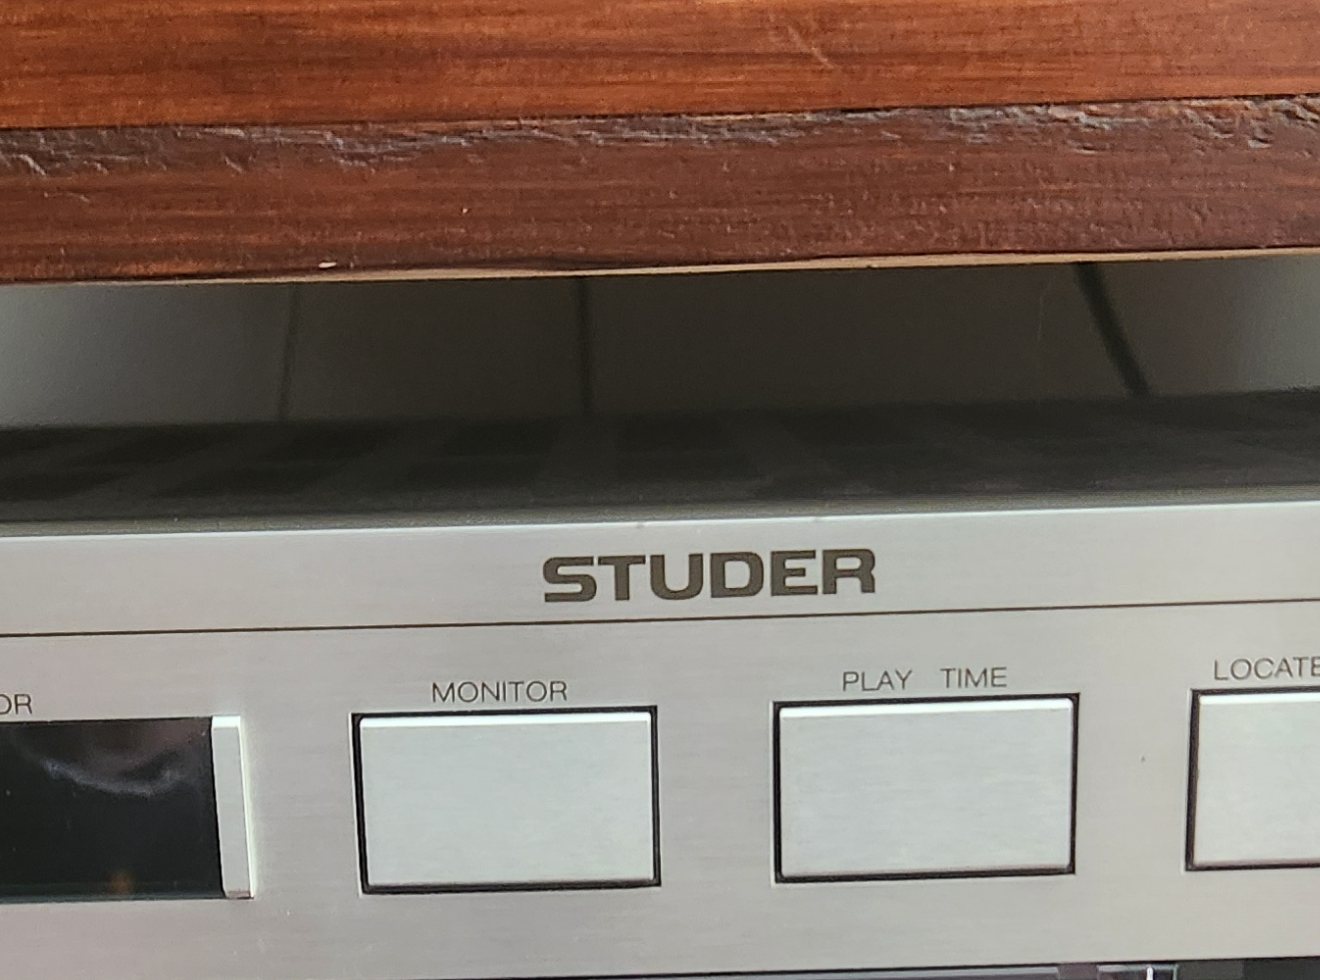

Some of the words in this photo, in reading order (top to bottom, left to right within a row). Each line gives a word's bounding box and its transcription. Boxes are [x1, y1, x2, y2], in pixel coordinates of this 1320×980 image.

[542, 548, 876, 603] STUDER
[432, 680, 567, 703] MONITOR
[842, 669, 913, 692] PLAY
[940, 666, 1007, 689] TIME
